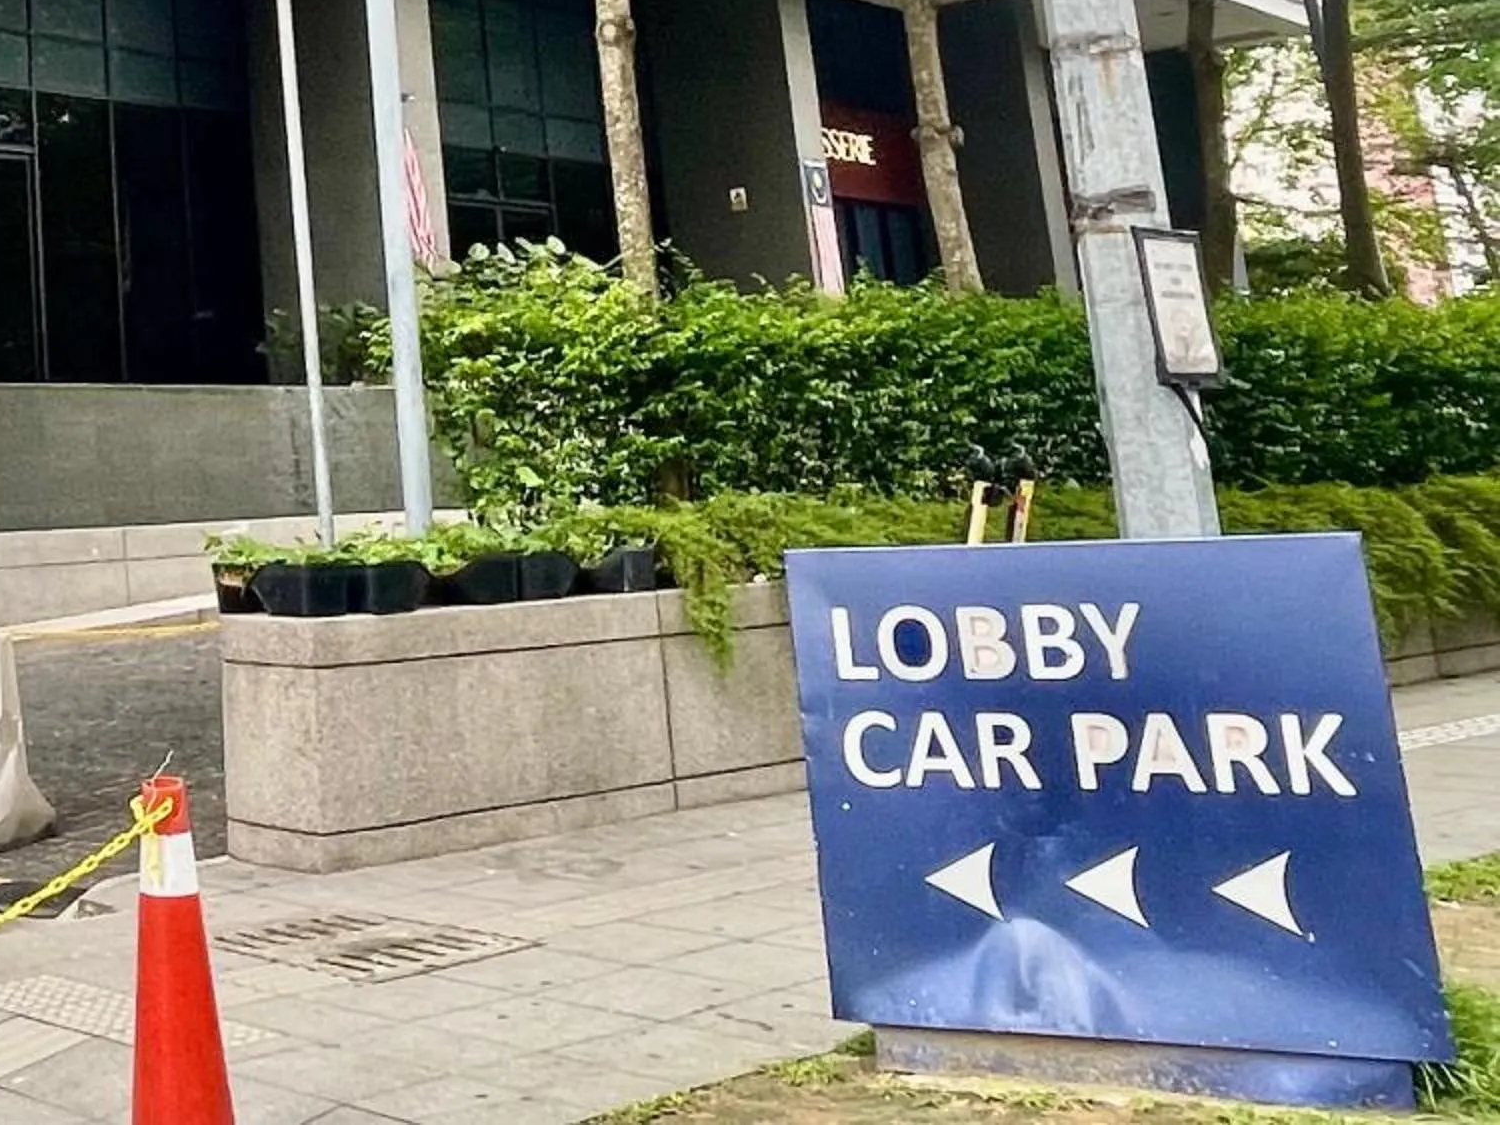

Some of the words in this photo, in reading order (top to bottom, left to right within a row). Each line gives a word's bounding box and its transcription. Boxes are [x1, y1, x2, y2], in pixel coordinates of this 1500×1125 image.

[831, 602, 1140, 682] LOBBY
[843, 710, 1041, 790] CAR
[1071, 711, 1358, 797] PARK
